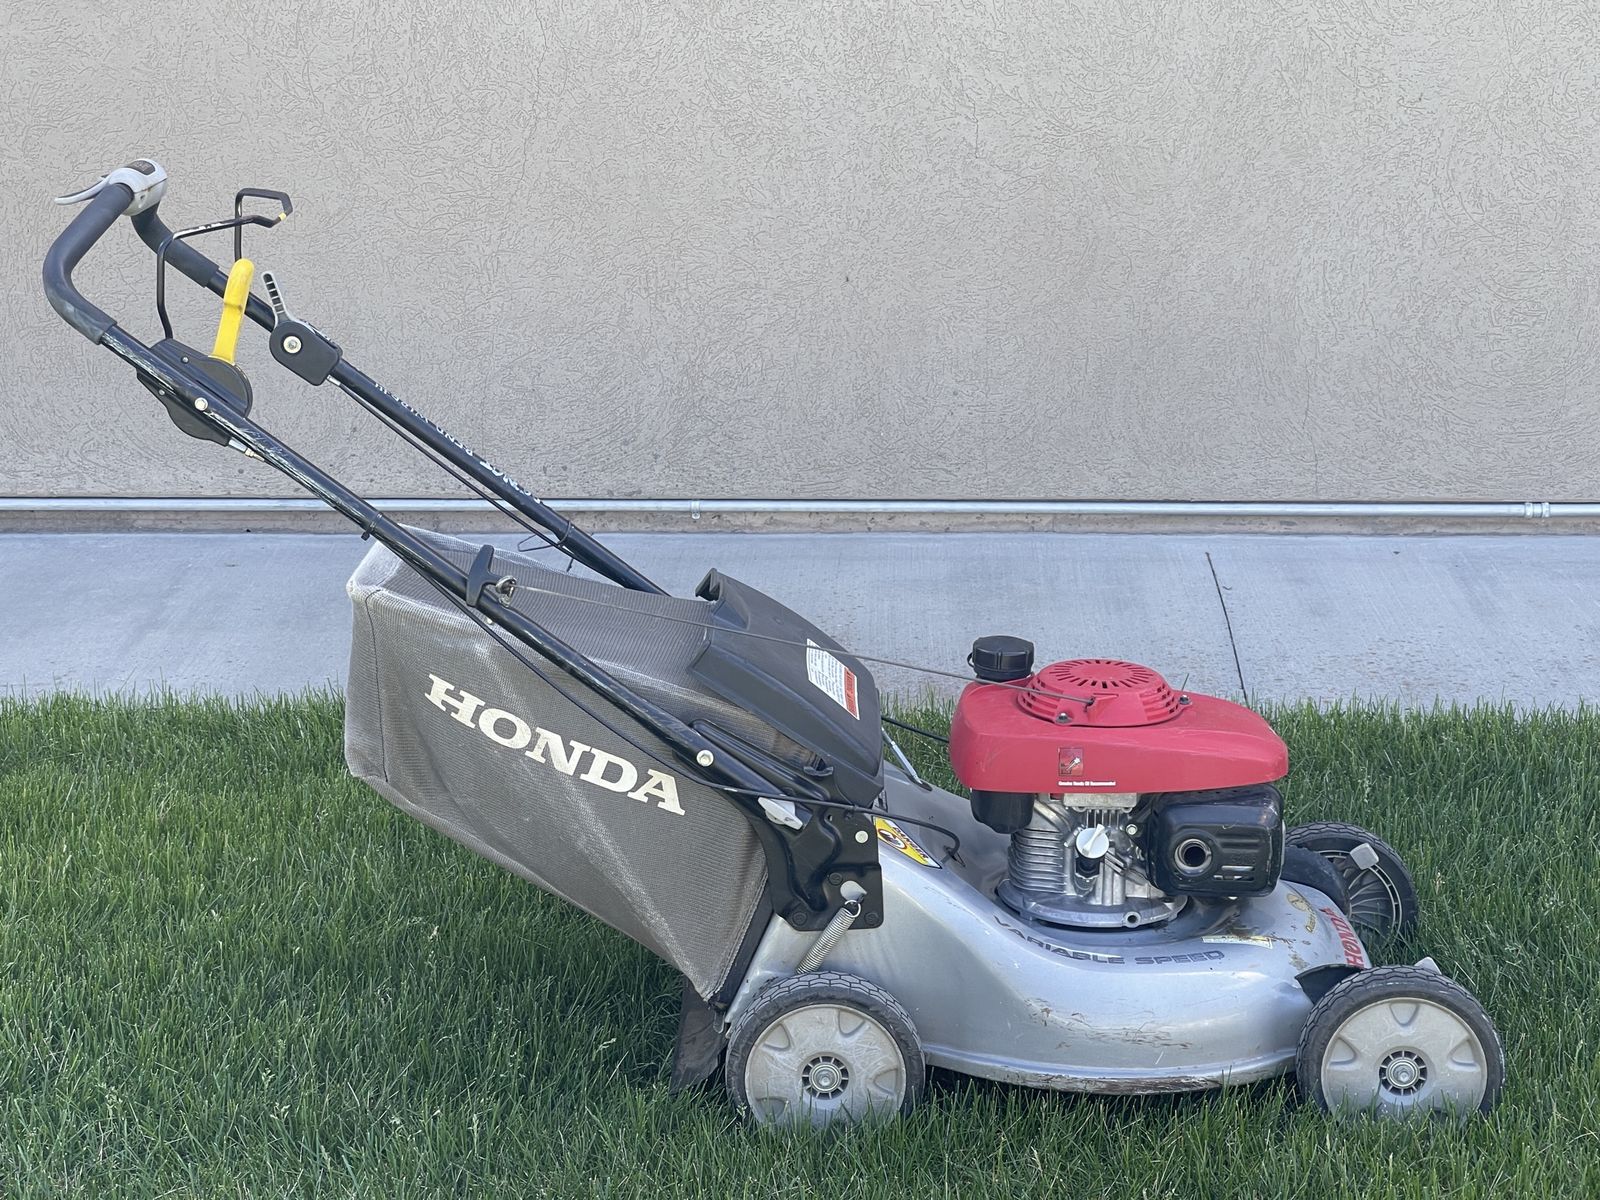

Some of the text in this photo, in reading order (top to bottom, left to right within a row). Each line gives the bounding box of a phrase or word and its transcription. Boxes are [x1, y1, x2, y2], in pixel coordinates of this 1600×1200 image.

[425, 674, 685, 816] HONDA
[993, 914, 1225, 965] VARIABLE SPEED
[1319, 907, 1365, 970] HONDA
